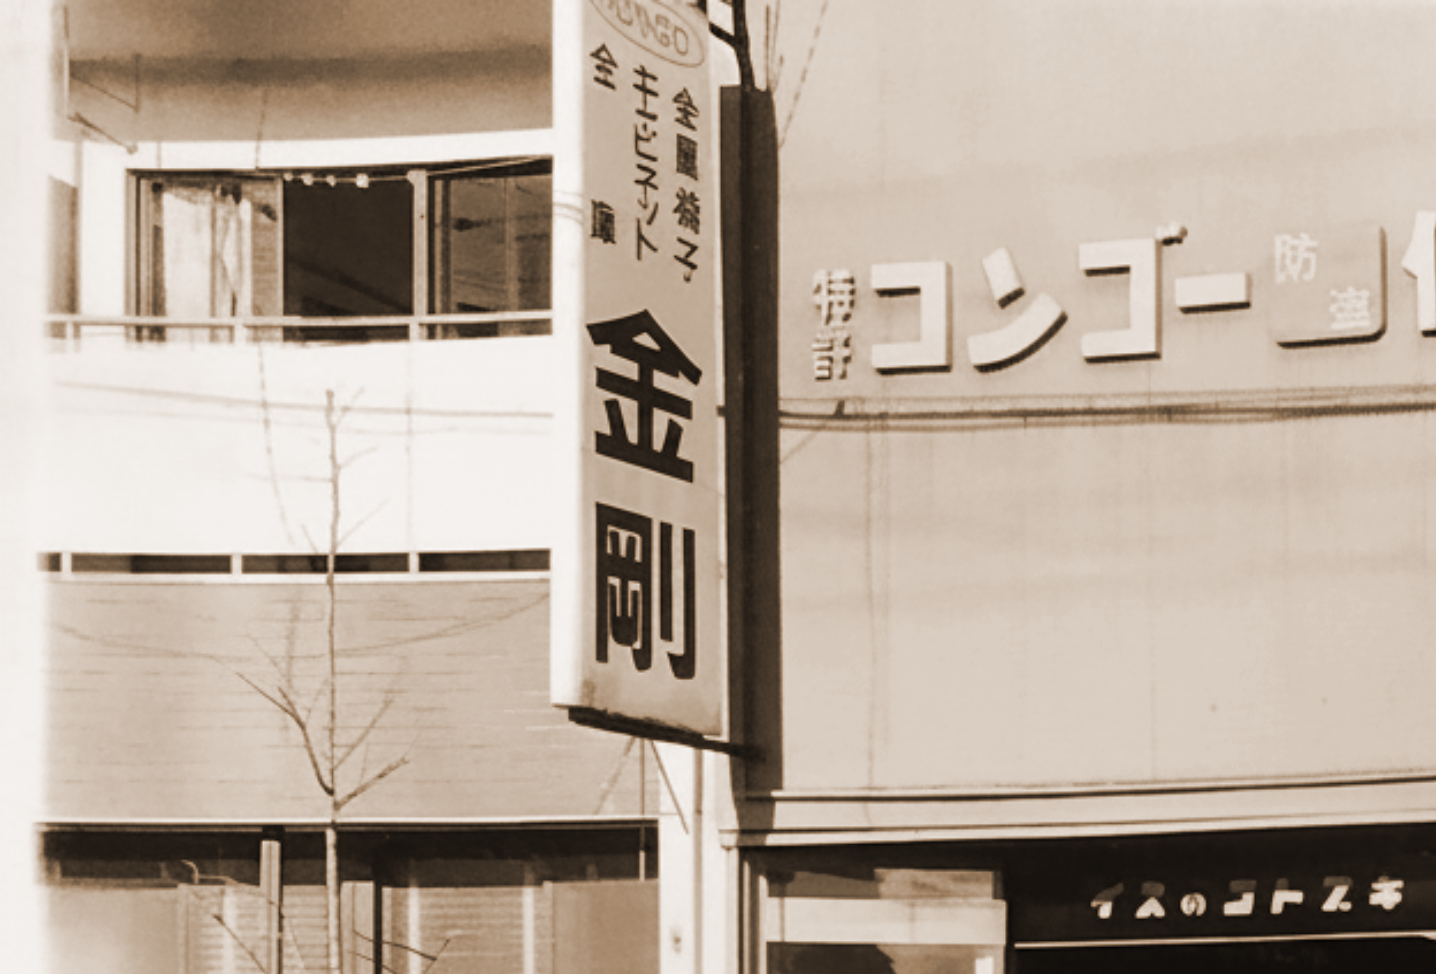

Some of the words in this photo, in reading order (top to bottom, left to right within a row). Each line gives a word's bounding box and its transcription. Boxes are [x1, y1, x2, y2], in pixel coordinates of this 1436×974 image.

[871, 221, 1253, 378] コンゴー
[586, 308, 703, 681] 金剛
